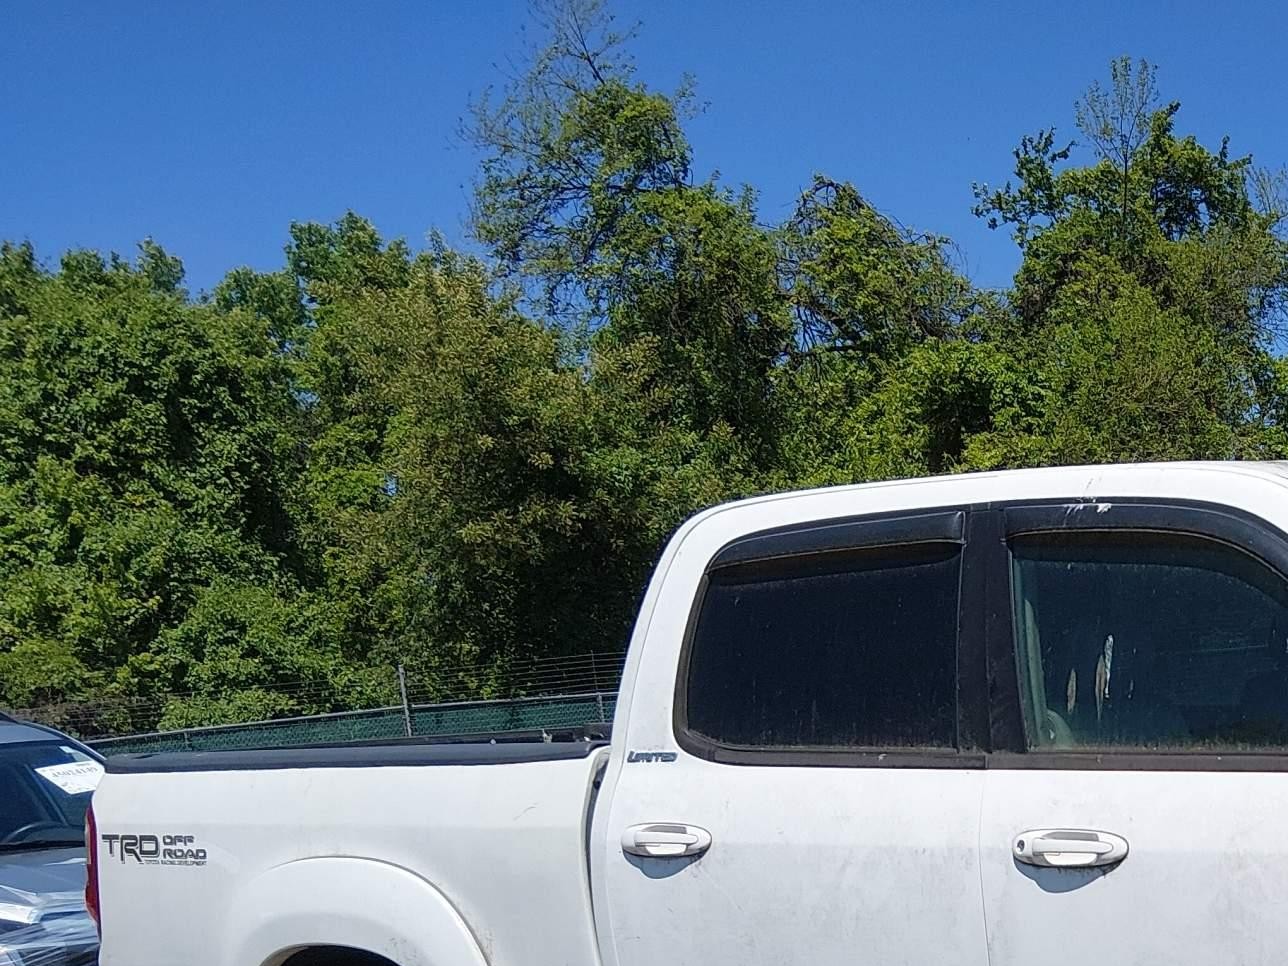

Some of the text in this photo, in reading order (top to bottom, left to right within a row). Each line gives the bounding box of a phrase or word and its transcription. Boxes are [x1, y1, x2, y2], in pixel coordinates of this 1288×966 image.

[163, 835, 194, 846] OFF
[101, 834, 160, 863] TRD
[163, 848, 207, 860] ROAD
